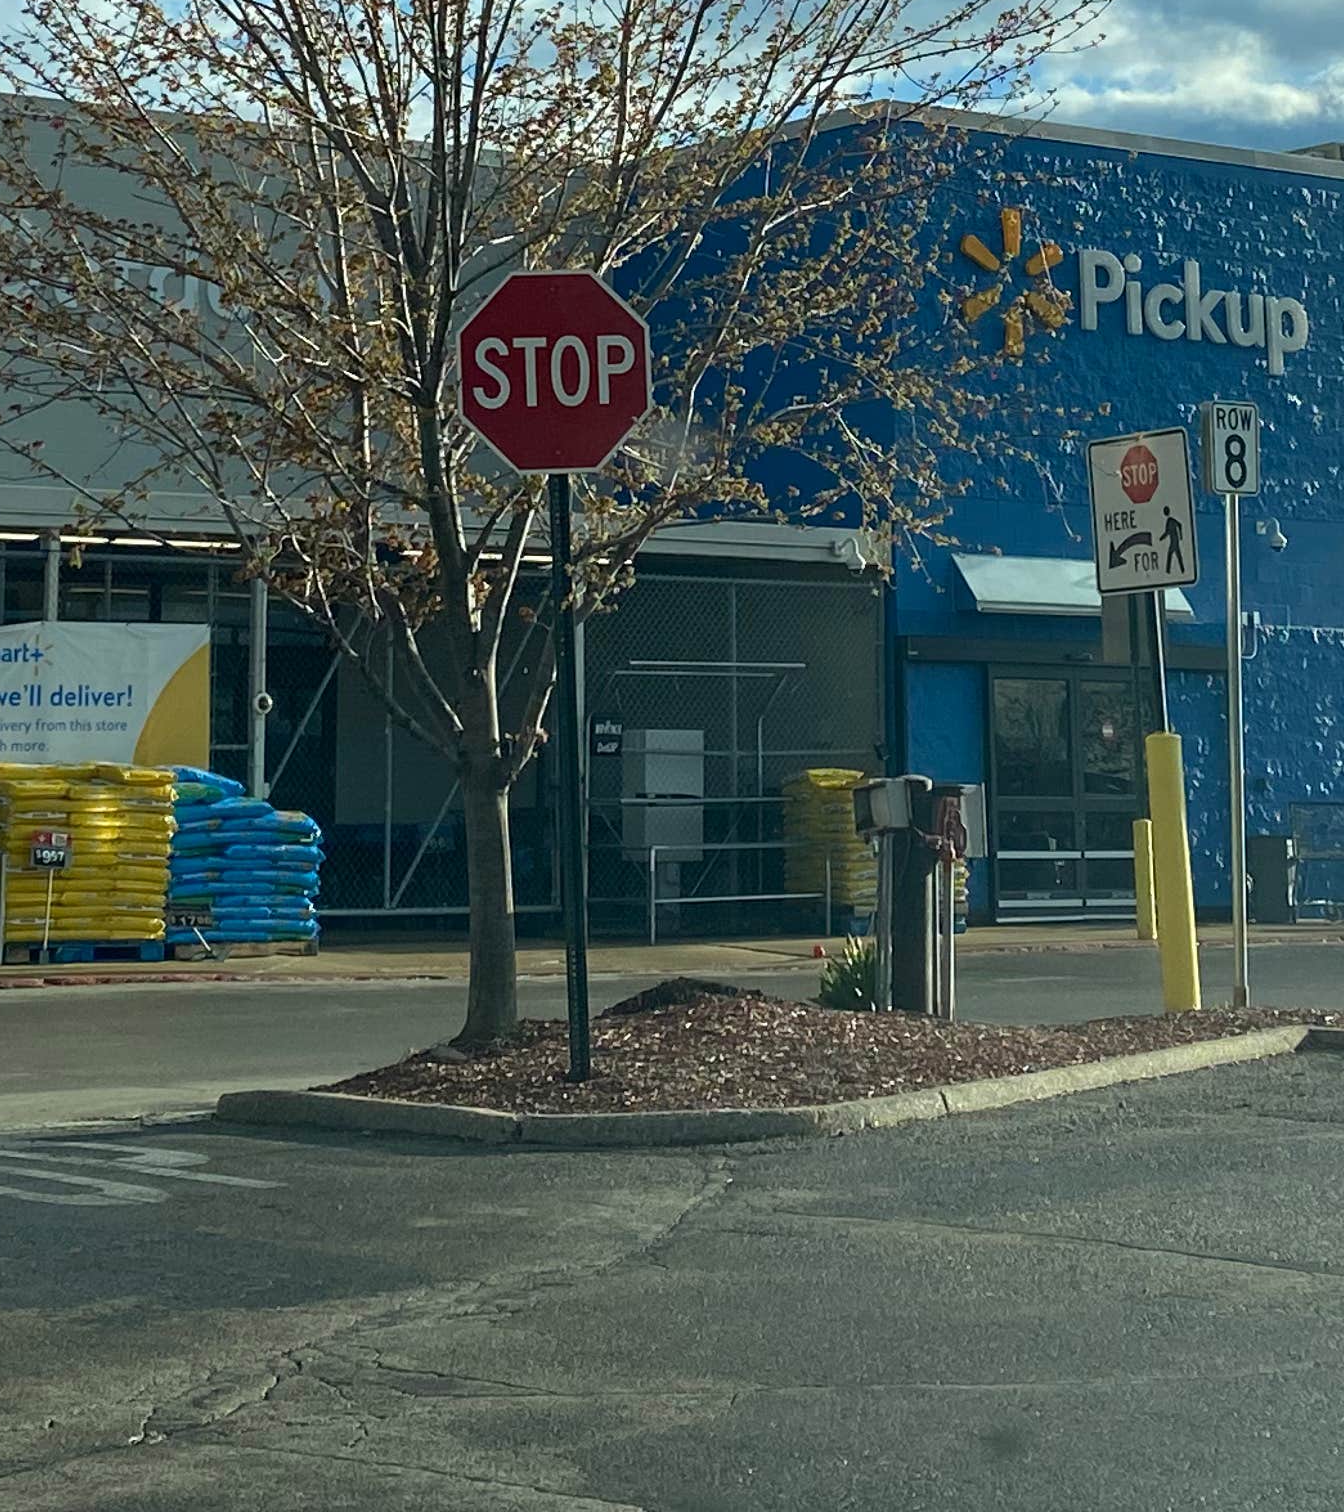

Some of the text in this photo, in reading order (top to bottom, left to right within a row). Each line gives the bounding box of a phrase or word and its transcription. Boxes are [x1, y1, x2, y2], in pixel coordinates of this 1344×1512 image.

[1079, 249, 1309, 376] Pickup
[472, 335, 635, 409] STOP
[1216, 407, 1252, 431] ROW
[1225, 434, 1247, 488] 8
[1122, 462, 1157, 487] STOP
[1104, 510, 1137, 531] HERE
[1134, 552, 1159, 572] FOR
[50, 684, 133, 707] deliver!
[35, 719, 66, 732] from
[69, 719, 92, 732] this
[95, 721, 128, 732] store
